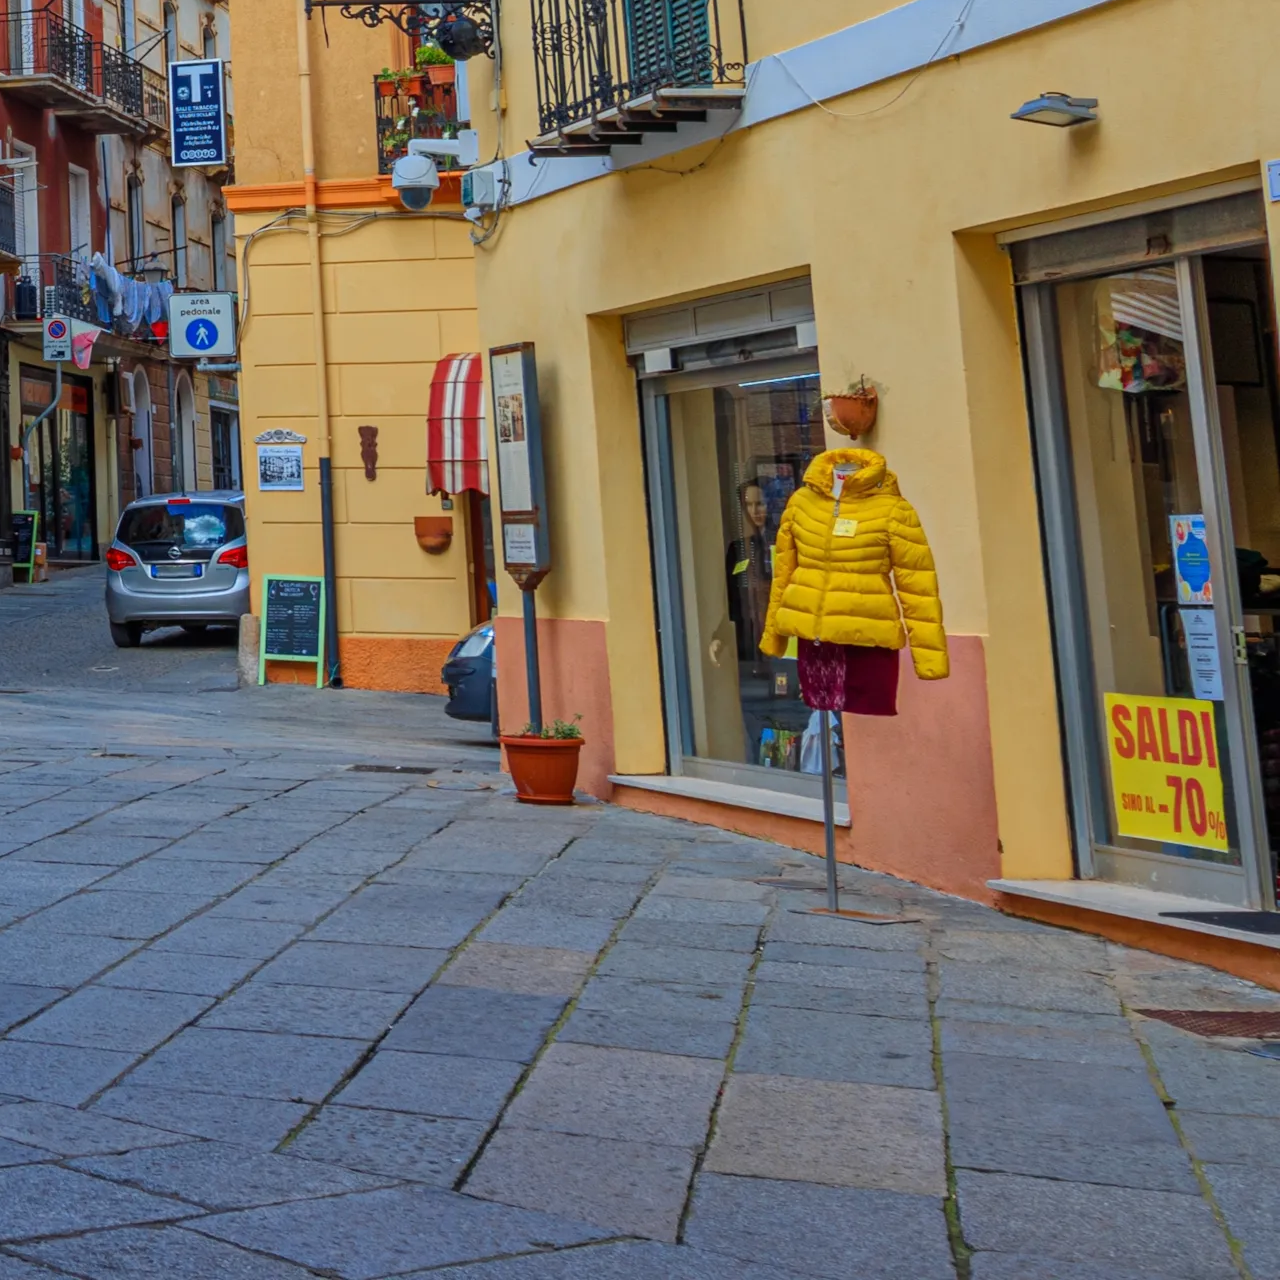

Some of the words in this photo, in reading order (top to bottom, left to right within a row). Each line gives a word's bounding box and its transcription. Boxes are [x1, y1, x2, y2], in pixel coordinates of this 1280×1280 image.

[177, 64, 214, 103] T
[180, 307, 221, 316] pedonale
[1111, 704, 1217, 768] SALDI
[1145, 794, 1156, 813] AL
